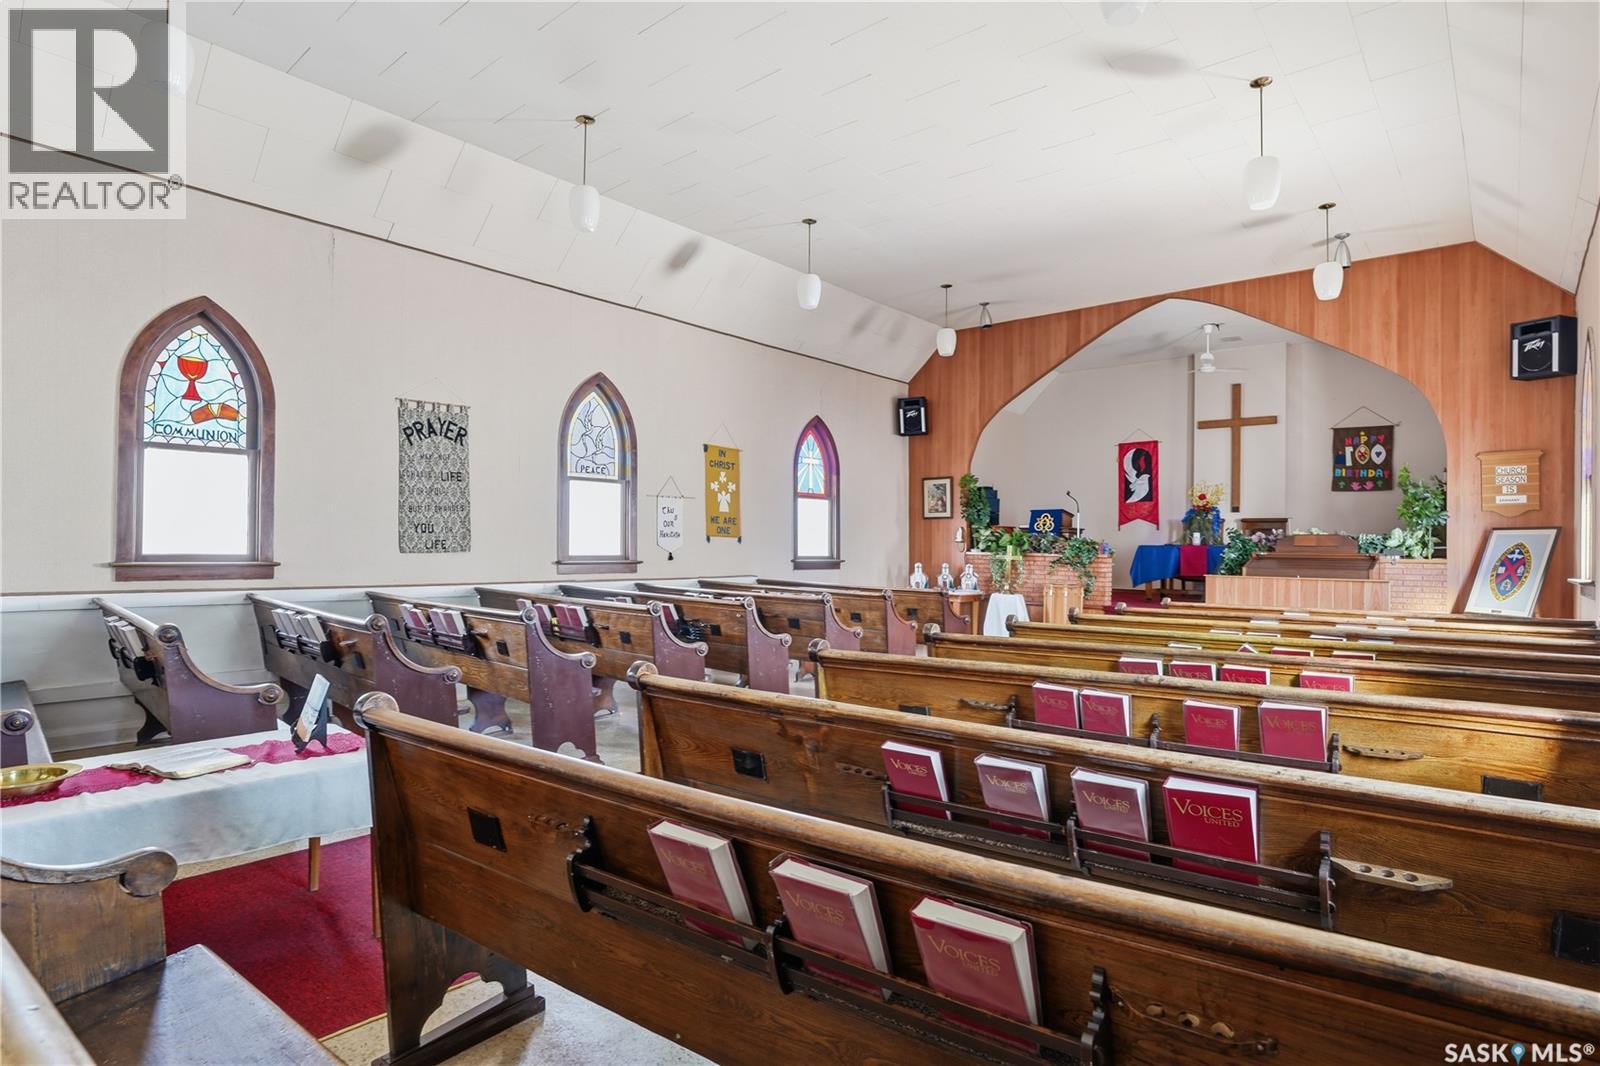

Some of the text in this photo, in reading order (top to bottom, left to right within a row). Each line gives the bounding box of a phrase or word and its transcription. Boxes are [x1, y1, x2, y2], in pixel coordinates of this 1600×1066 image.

[154, 423, 237, 442] COMMUNION
[402, 416, 468, 446] PRAYER
[718, 449, 727, 458] IN
[580, 464, 606, 475] PEACE
[709, 459, 735, 471] CHRIST
[1496, 466, 1526, 475] CHURCH
[440, 471, 462, 482] LIFE
[1334, 467, 1391, 479] BIRTHDAY
[1496, 476, 1526, 484] SEASON
[710, 515, 737, 526] WE ARE
[413, 523, 435, 534] YOU
[716, 526, 731, 535] ONE
[425, 539, 447, 550] LIFE
[1265, 715, 1318, 732] VOICES
[890, 757, 929, 774] VOICES
[985, 774, 1029, 790] VOICES
[1082, 790, 1131, 809] VOICES
[1172, 797, 1244, 822] VOICES
[1204, 817, 1241, 828] UNITED
[658, 847, 705, 873] VOICES
[785, 889, 847, 923] VOICES
[927, 935, 1001, 971] VOICES
